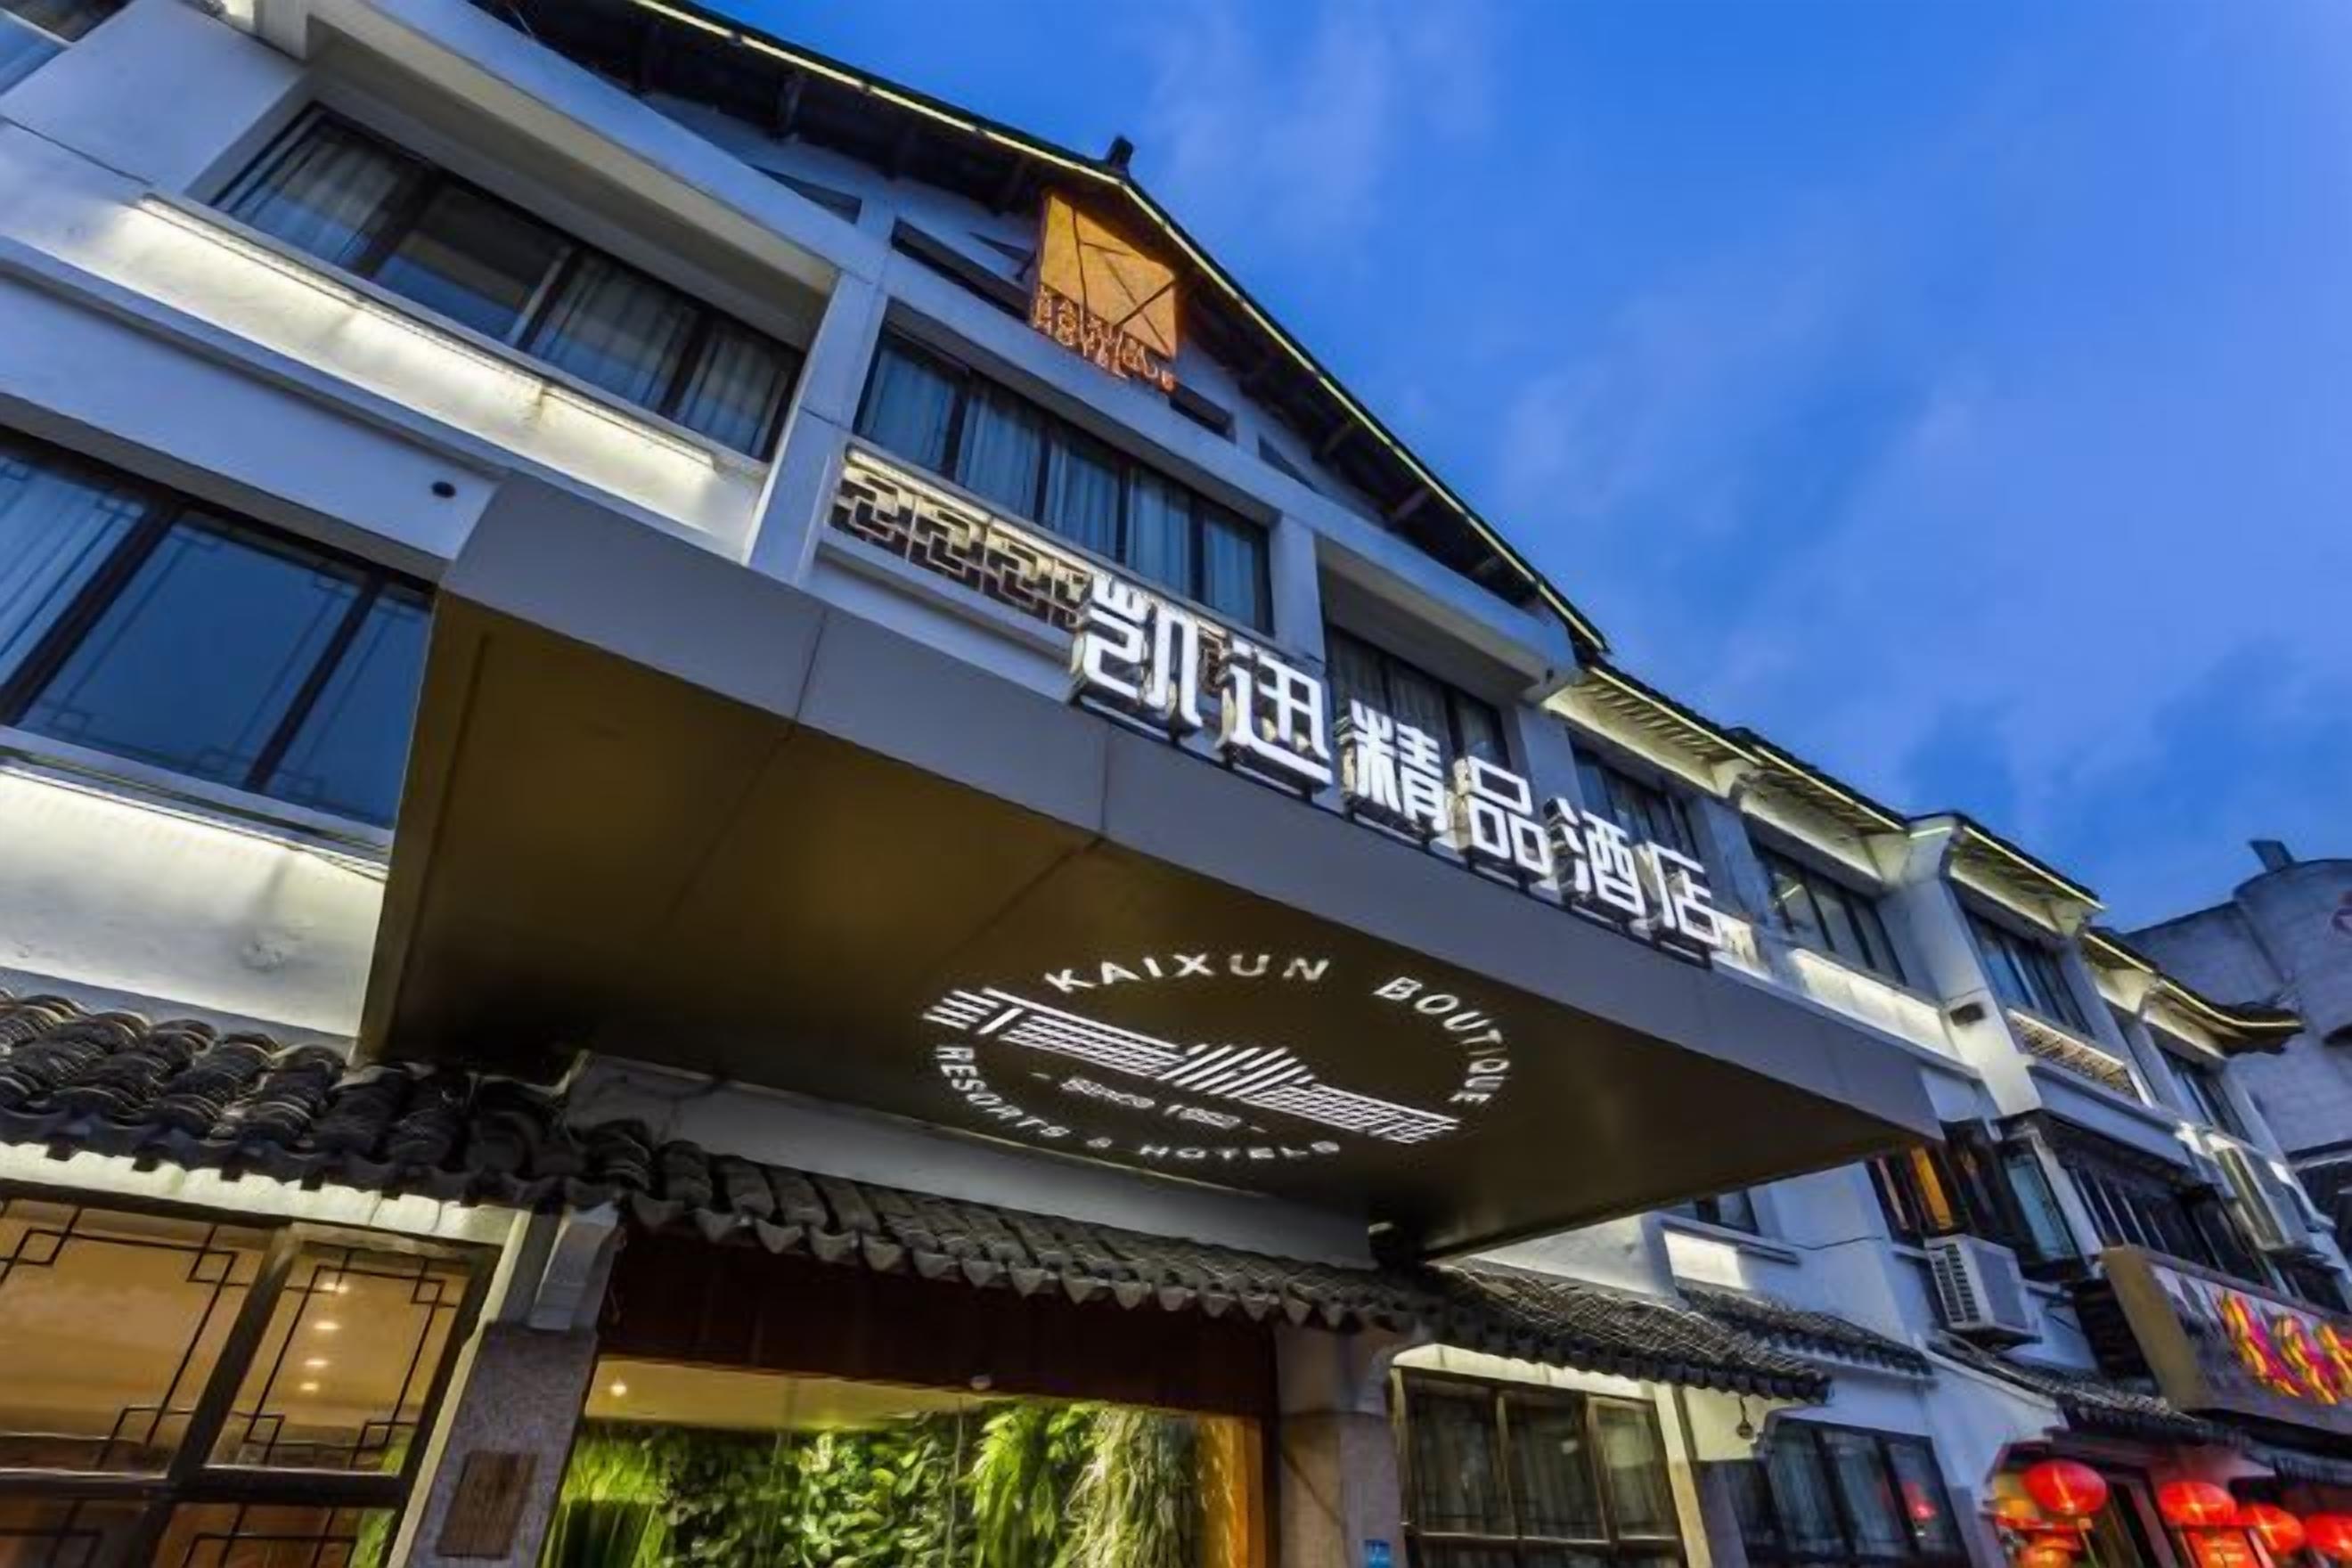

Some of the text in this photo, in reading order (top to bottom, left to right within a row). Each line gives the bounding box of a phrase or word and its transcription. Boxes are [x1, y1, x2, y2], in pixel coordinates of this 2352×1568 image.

[1082, 571, 1723, 947] 凯迅精品酒店
[935, 1044, 1071, 1138] RESORTS
[1139, 1140, 1340, 1160] HOTELS
[1044, 952, 1511, 1105] KAIXUN BOUTIQUE
